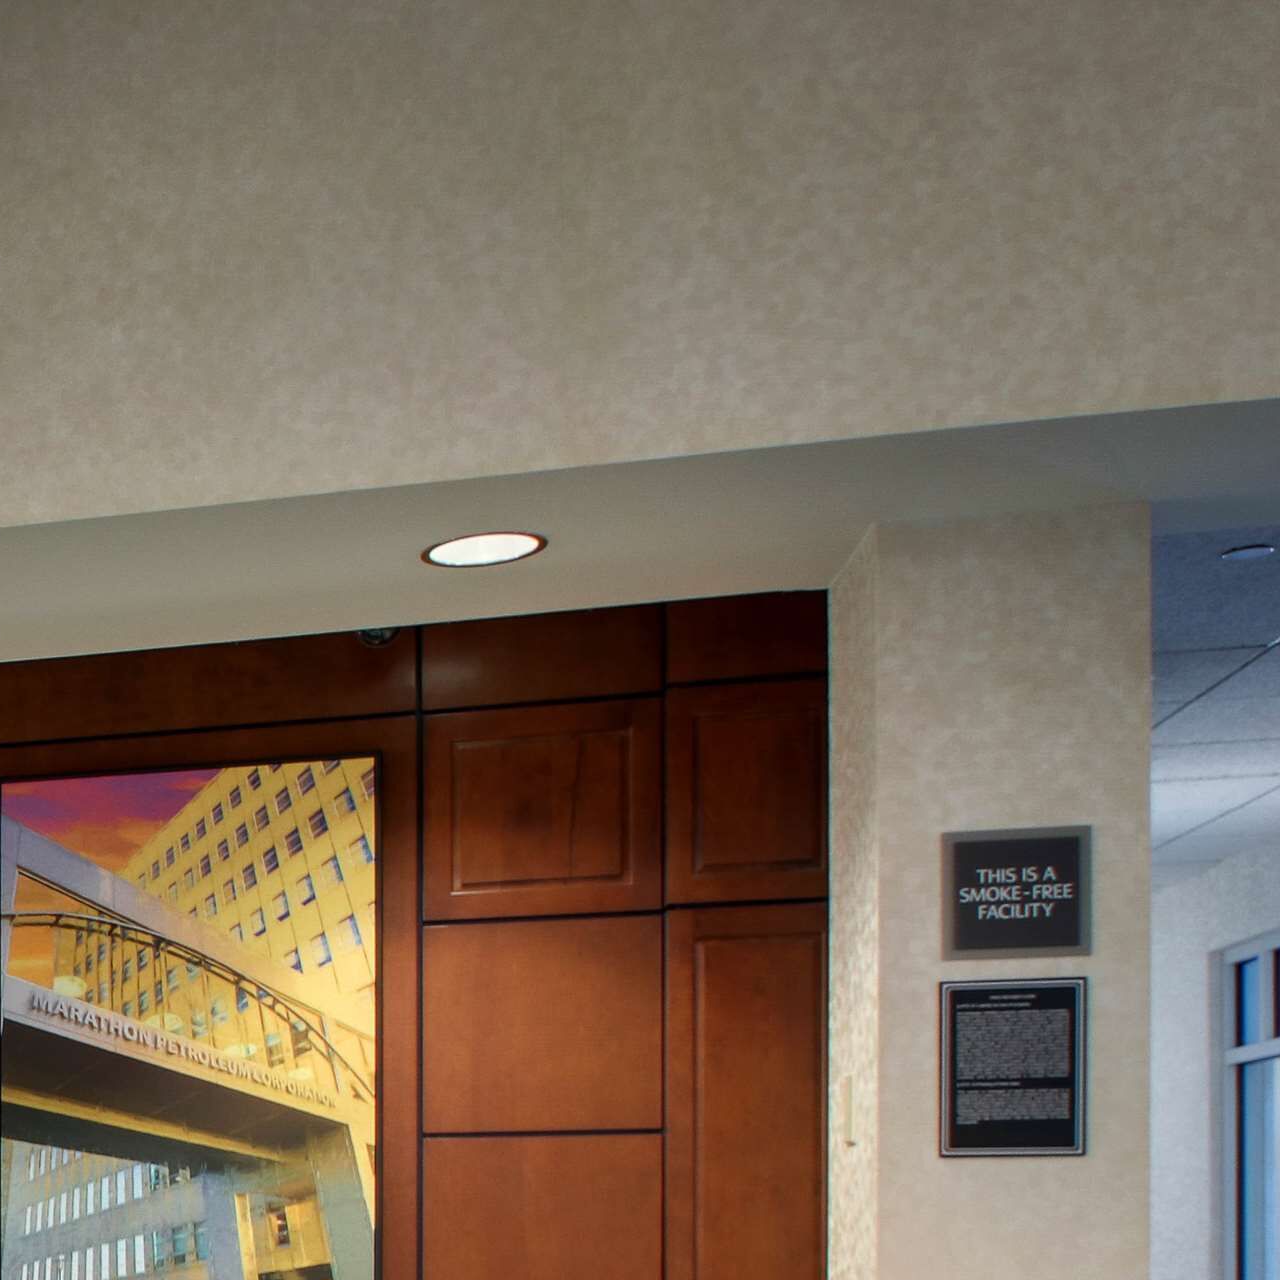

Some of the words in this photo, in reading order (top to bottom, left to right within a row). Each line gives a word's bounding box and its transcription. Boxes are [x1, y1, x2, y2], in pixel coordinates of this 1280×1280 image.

[976, 868, 1017, 884] THIS
[1022, 867, 1038, 882] IS
[1042, 866, 1056, 881] A
[959, 883, 1073, 903] SMOKE-FREE
[977, 902, 1055, 920] FACILITY
[31, 992, 153, 1047] MARATHON
[156, 1031, 252, 1079] PETROLEUM
